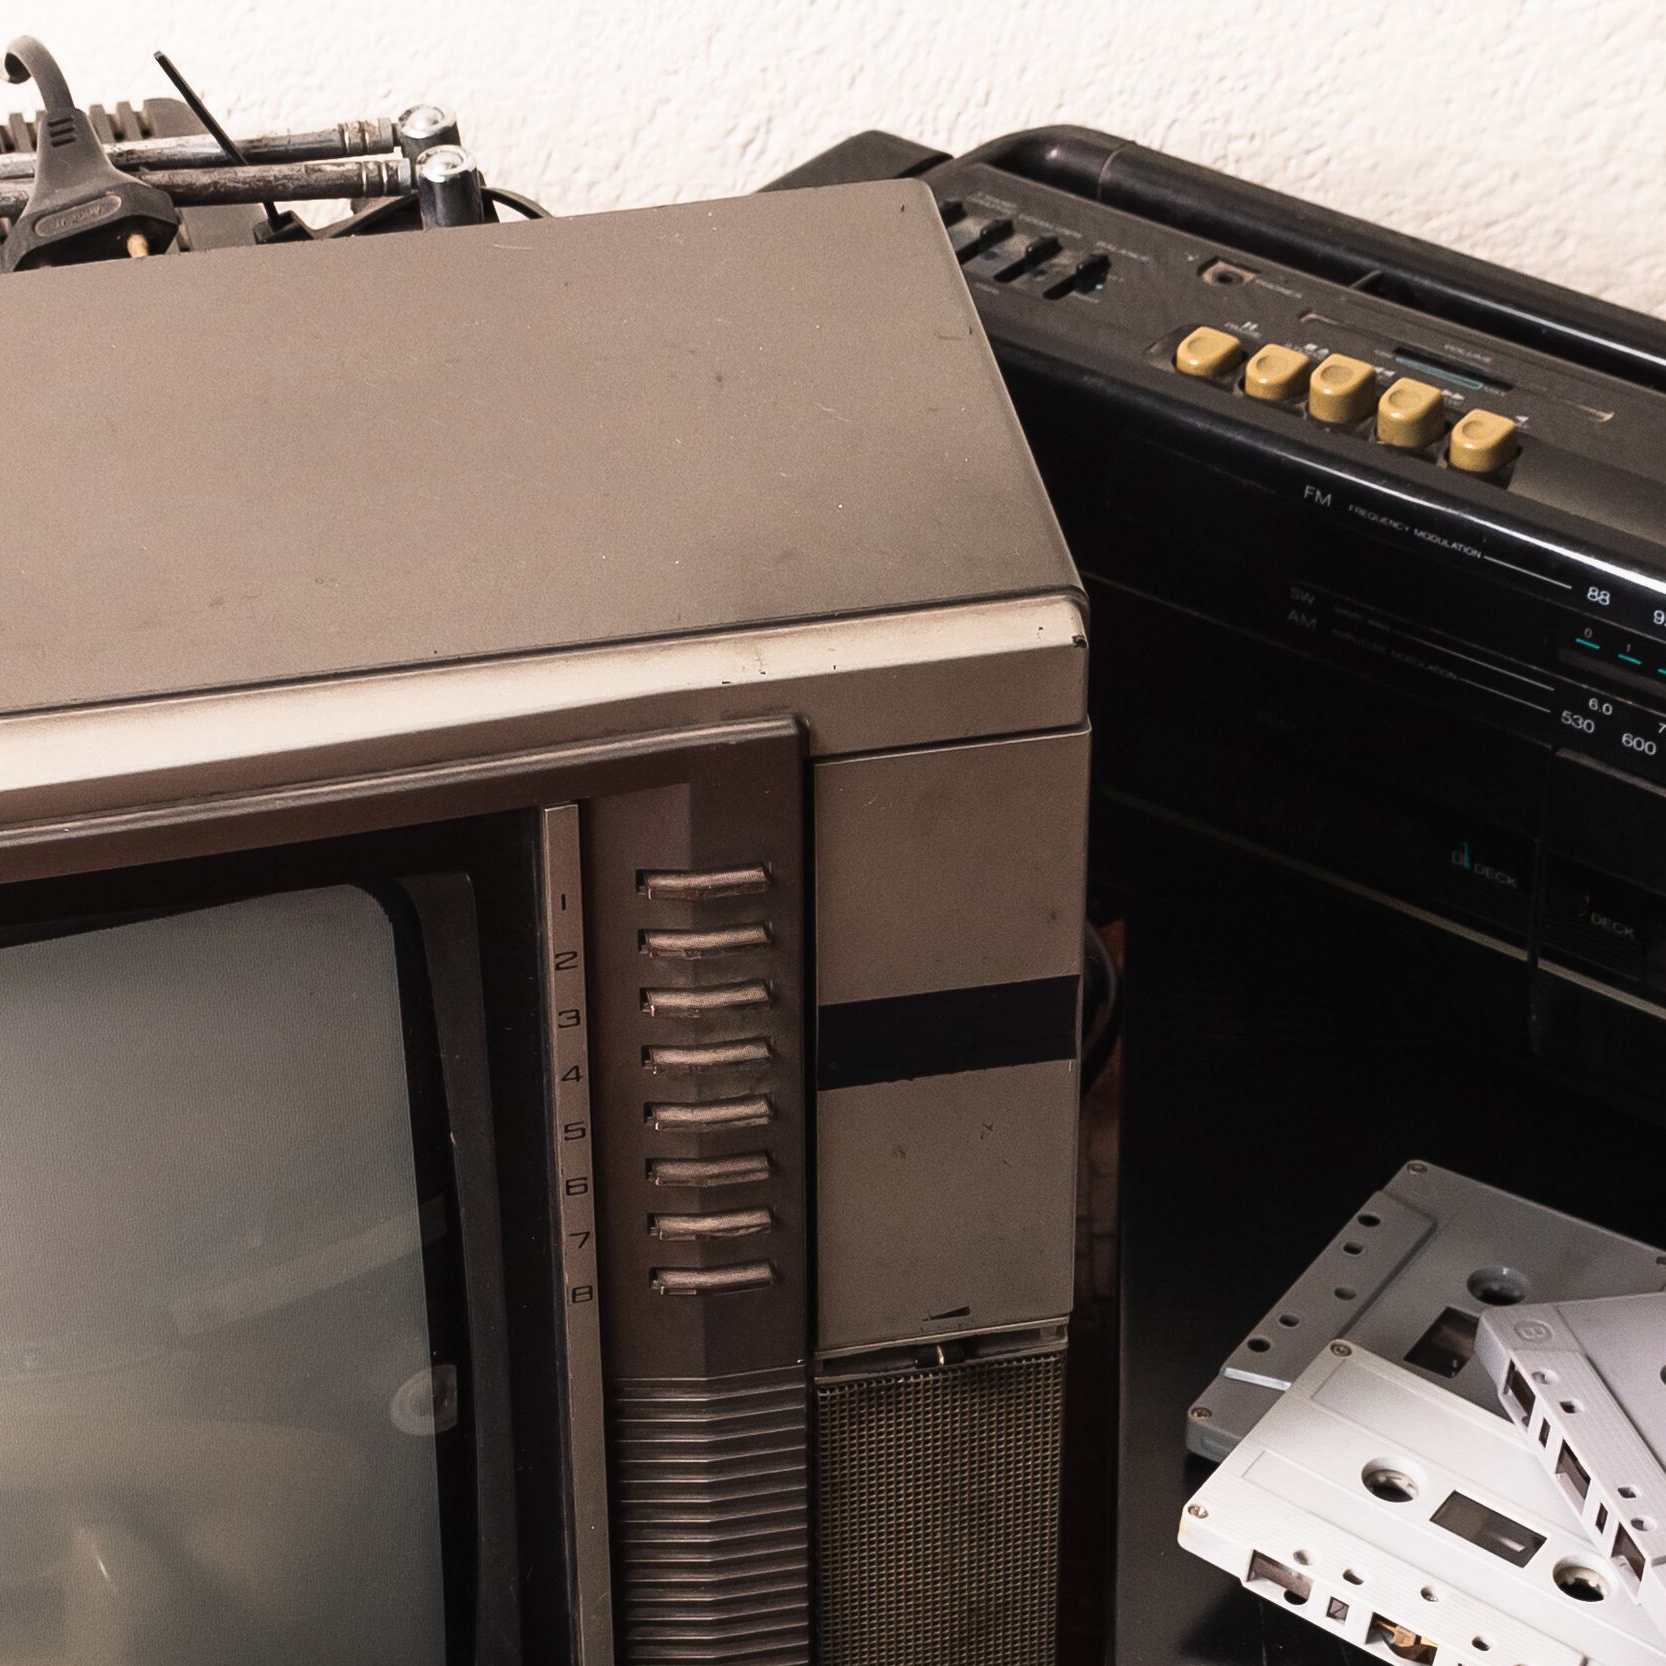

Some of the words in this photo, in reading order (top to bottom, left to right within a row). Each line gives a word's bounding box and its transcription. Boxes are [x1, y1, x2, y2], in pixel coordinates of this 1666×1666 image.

[1304, 485, 1331, 507] FM
[1349, 504, 1410, 532] FREQUENCY
[1414, 528, 1481, 558] MODULATION
[1587, 587, 1610, 605] 88
[1287, 610, 1317, 630] AM
[1583, 628, 1593, 639] 0
[1589, 698, 1613, 715] 6.0
[1561, 711, 1595, 734] 530
[1621, 733, 1657, 756] 600
[1590, 912, 1635, 938] DECK
[555, 951, 578, 971] 2
[558, 1010, 581, 1029] 3
[560, 1065, 583, 1084] 4
[563, 1122, 586, 1141] 5
[565, 1178, 588, 1196] 6
[568, 1232, 591, 1249] 7
[572, 1285, 593, 1303] 8
